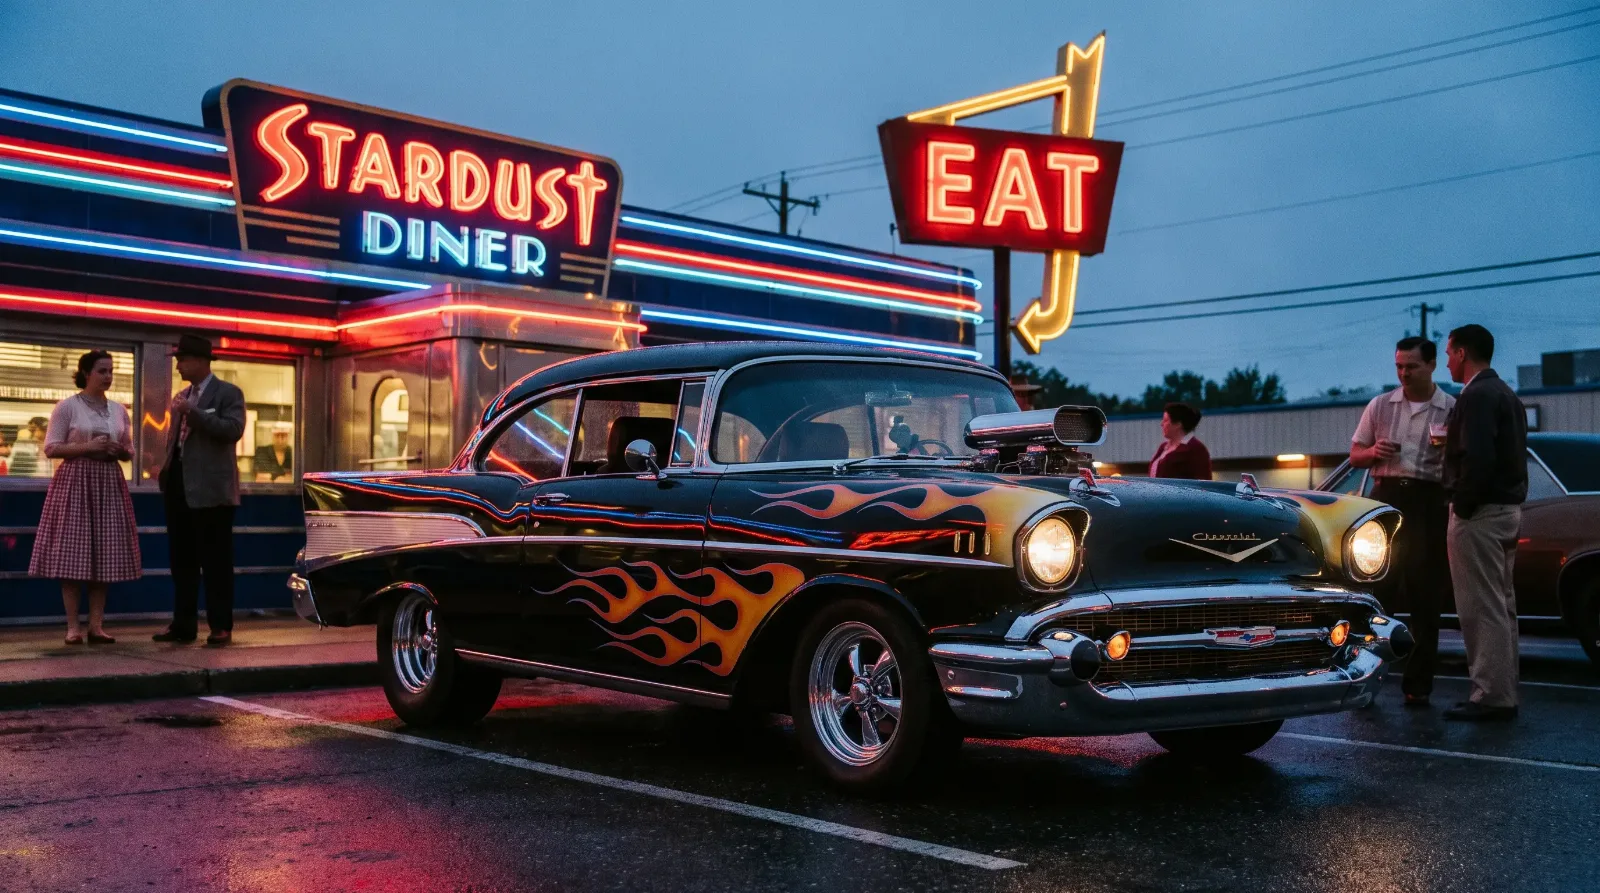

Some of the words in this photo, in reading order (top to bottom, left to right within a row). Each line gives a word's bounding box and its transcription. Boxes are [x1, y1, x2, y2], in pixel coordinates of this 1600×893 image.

[257, 104, 608, 246] STARDUST
[926, 140, 1100, 234] EAT
[362, 211, 547, 277] DINER
[1191, 532, 1262, 541] Chevrolet
